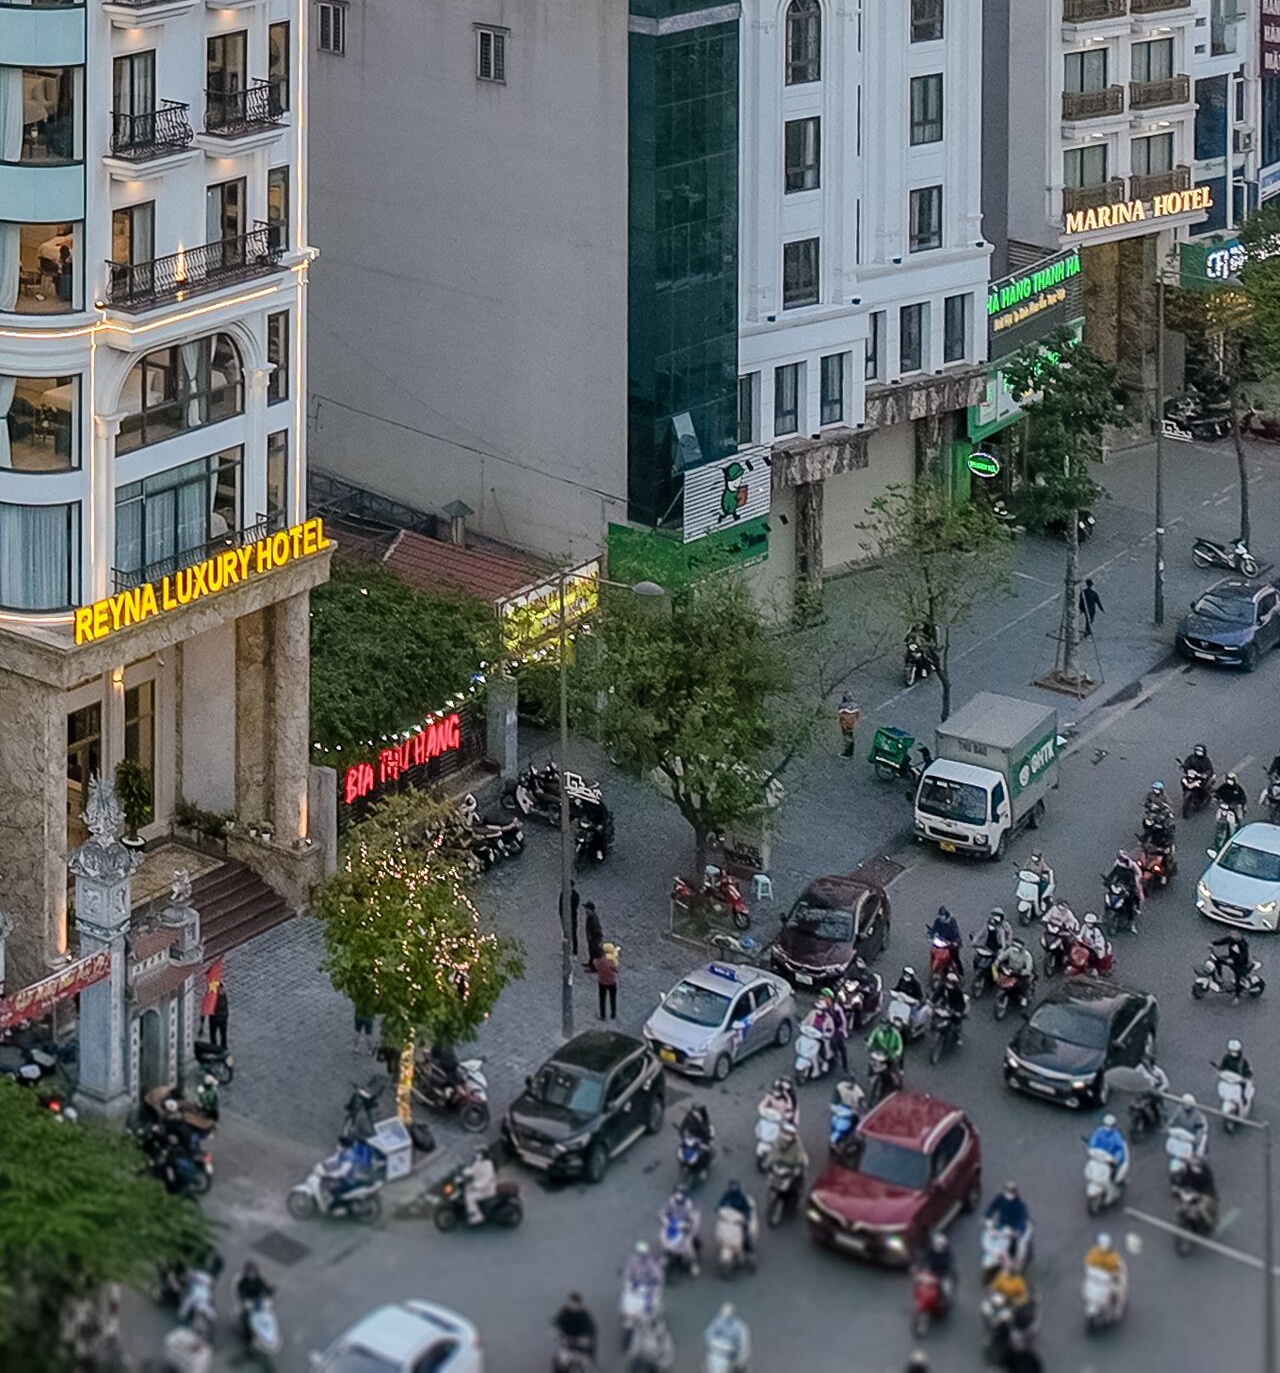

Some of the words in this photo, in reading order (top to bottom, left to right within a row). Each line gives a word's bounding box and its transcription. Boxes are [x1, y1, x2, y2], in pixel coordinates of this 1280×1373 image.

[1065, 199, 1146, 235] MARINA
[1153, 186, 1214, 218] HOTEL
[74, 583, 159, 645] REYNA
[162, 546, 253, 612] LUXURY
[256, 517, 331, 574] HOTEL
[345, 762, 374, 805] BIA
[379, 738, 410, 784] THU
